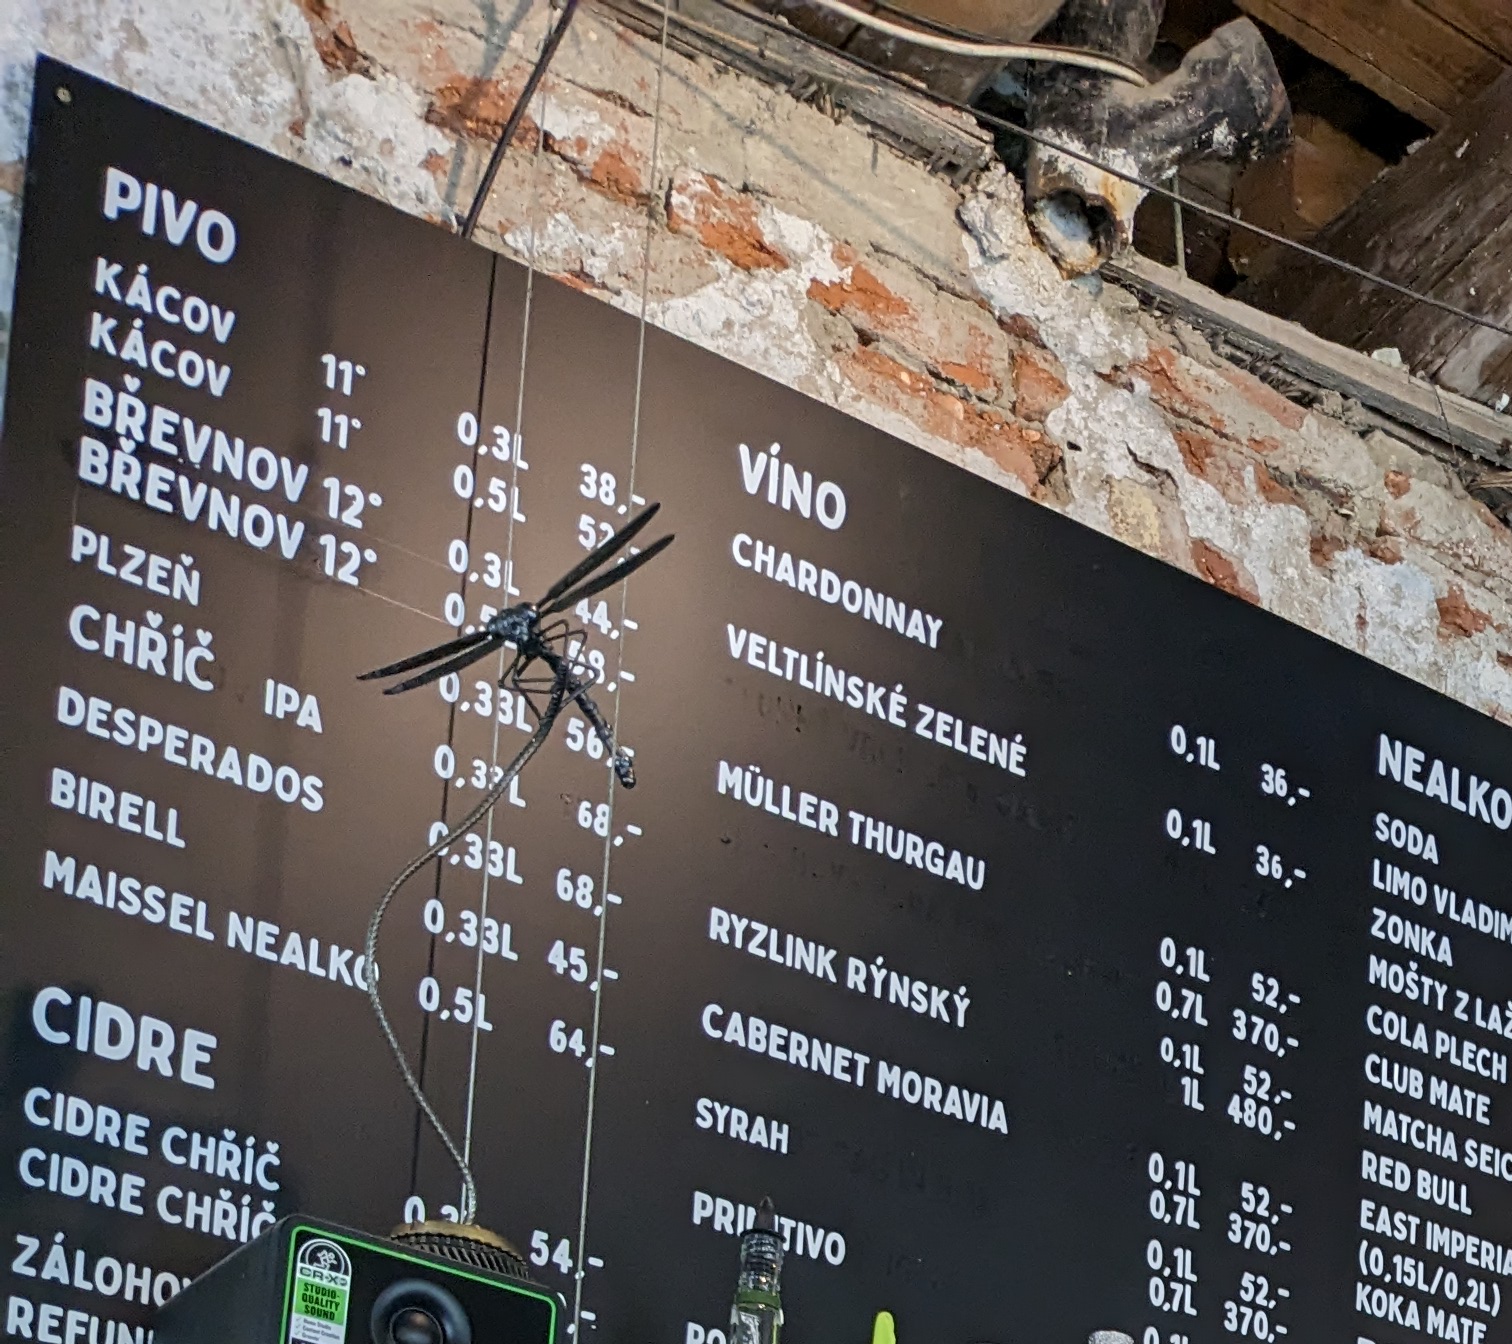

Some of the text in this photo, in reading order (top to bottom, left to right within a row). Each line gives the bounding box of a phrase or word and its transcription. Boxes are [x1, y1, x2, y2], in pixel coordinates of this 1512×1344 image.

[103, 166, 236, 263] PIVO
[95, 257, 235, 344] KÁCOV
[90, 312, 230, 397] KÁCOV
[83, 375, 308, 501] BŘEVNOV
[78, 435, 304, 560] BŘEVNOV
[738, 443, 847, 530] VÍNO
[72, 525, 200, 606] PLZEŇ
[732, 533, 943, 649] CHARDONNAY
[69, 604, 323, 734] CHŘÍČ IPA
[727, 623, 1027, 777] VELTLÍNSKÉ ZELENÉ
[57, 687, 324, 812] DESPERADOS
[1378, 733, 1512, 831] NEALKO
[51, 767, 186, 849] BIRELL
[717, 760, 986, 890] MÜLLER THURGAU
[1375, 812, 1439, 865] SODA
[42, 851, 214, 943] MAISSEL
[1373, 858, 1426, 906] LIMO
[709, 906, 970, 1029] RYZLINK RÝNSKÝ
[1371, 907, 1452, 967] ZONKA
[1369, 955, 1447, 1012] MOŠTY
[1454, 989, 1469, 1020] Z
[31, 986, 217, 1089] CIDRE
[702, 1003, 1008, 1135] CABERNET MORAVIA
[1367, 1005, 1508, 1084] COLA PLECH
[696, 1097, 789, 1155] SYRAH
[1364, 1101, 1458, 1162] MATCHA
[1365, 1055, 1490, 1126] CLUB MATE
[24, 1086, 281, 1192] CIDRE CHŘÍČ
[19, 1148, 143, 1217] CIDRE
[1360, 1201, 1422, 1248] EAST
[1362, 1149, 1472, 1217] RED BULL
[302, 1292, 340, 1312] QUALITY
[304, 1304, 335, 1320] SOUND
[1355, 1282, 1422, 1331] KOKA
